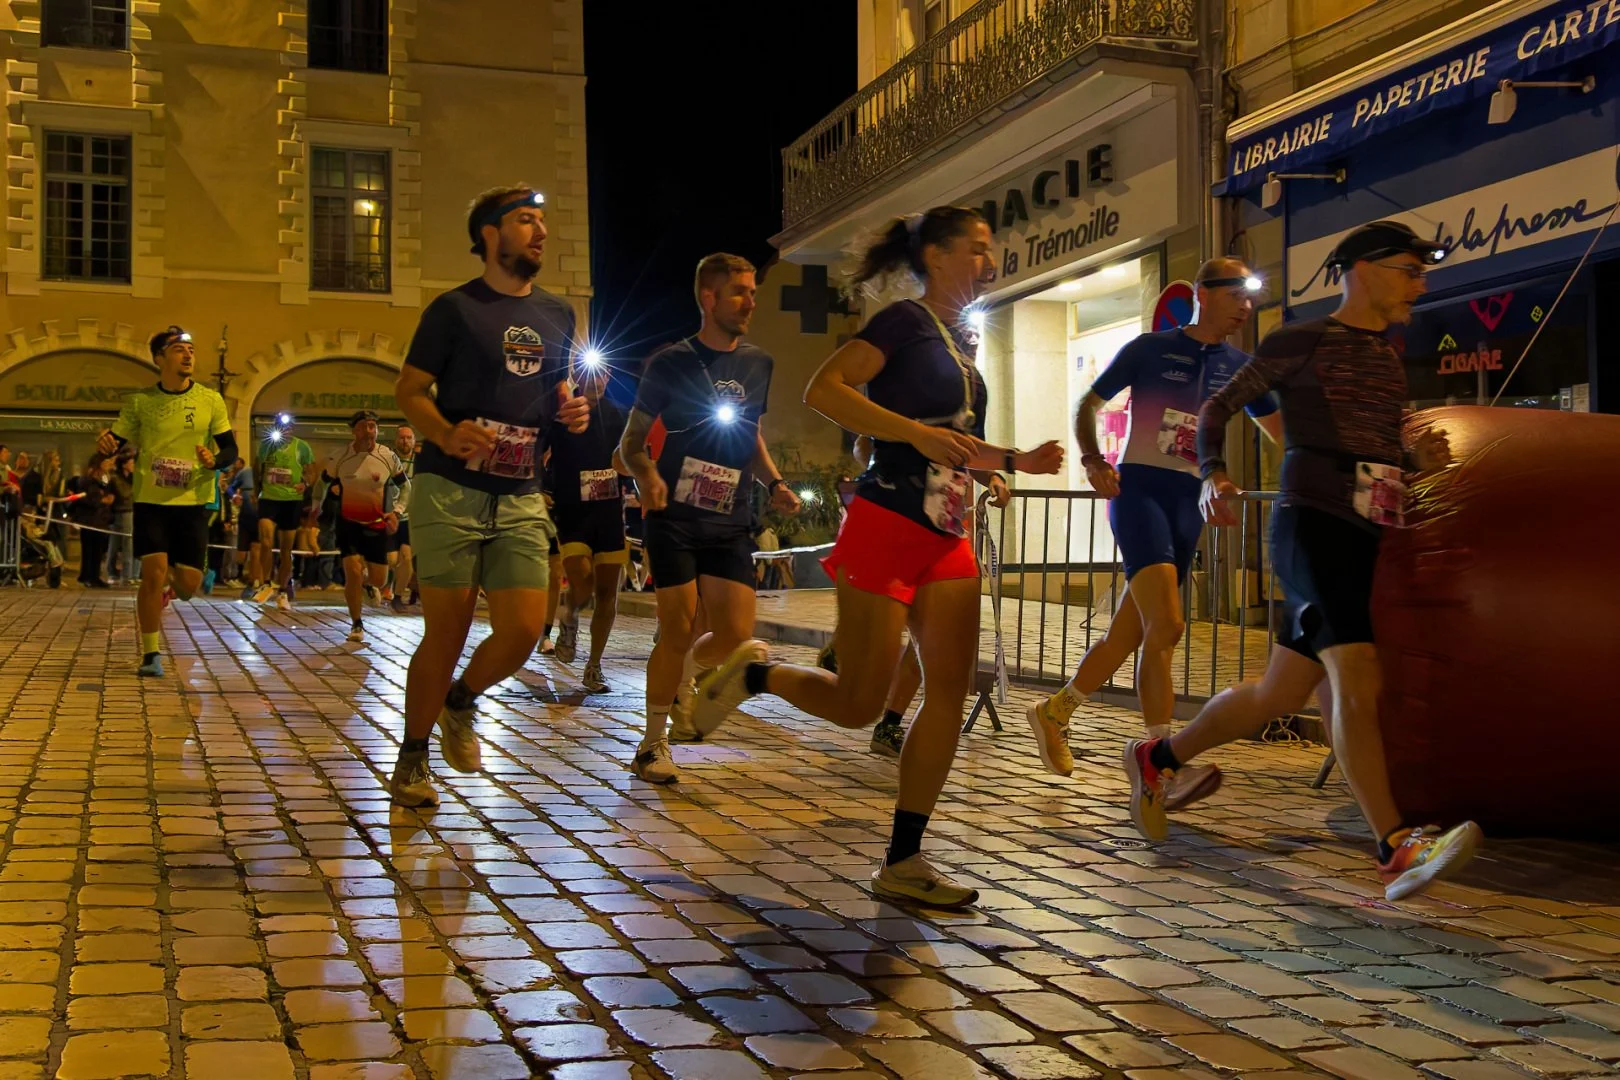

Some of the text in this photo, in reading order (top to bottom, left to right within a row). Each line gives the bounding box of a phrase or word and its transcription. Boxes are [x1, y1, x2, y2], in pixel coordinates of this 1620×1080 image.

[1233, 113, 1333, 176] LIBRAIRIE
[1352, 46, 1491, 128] PAPETERIE
[1002, 205, 1120, 278] la Trémoille
